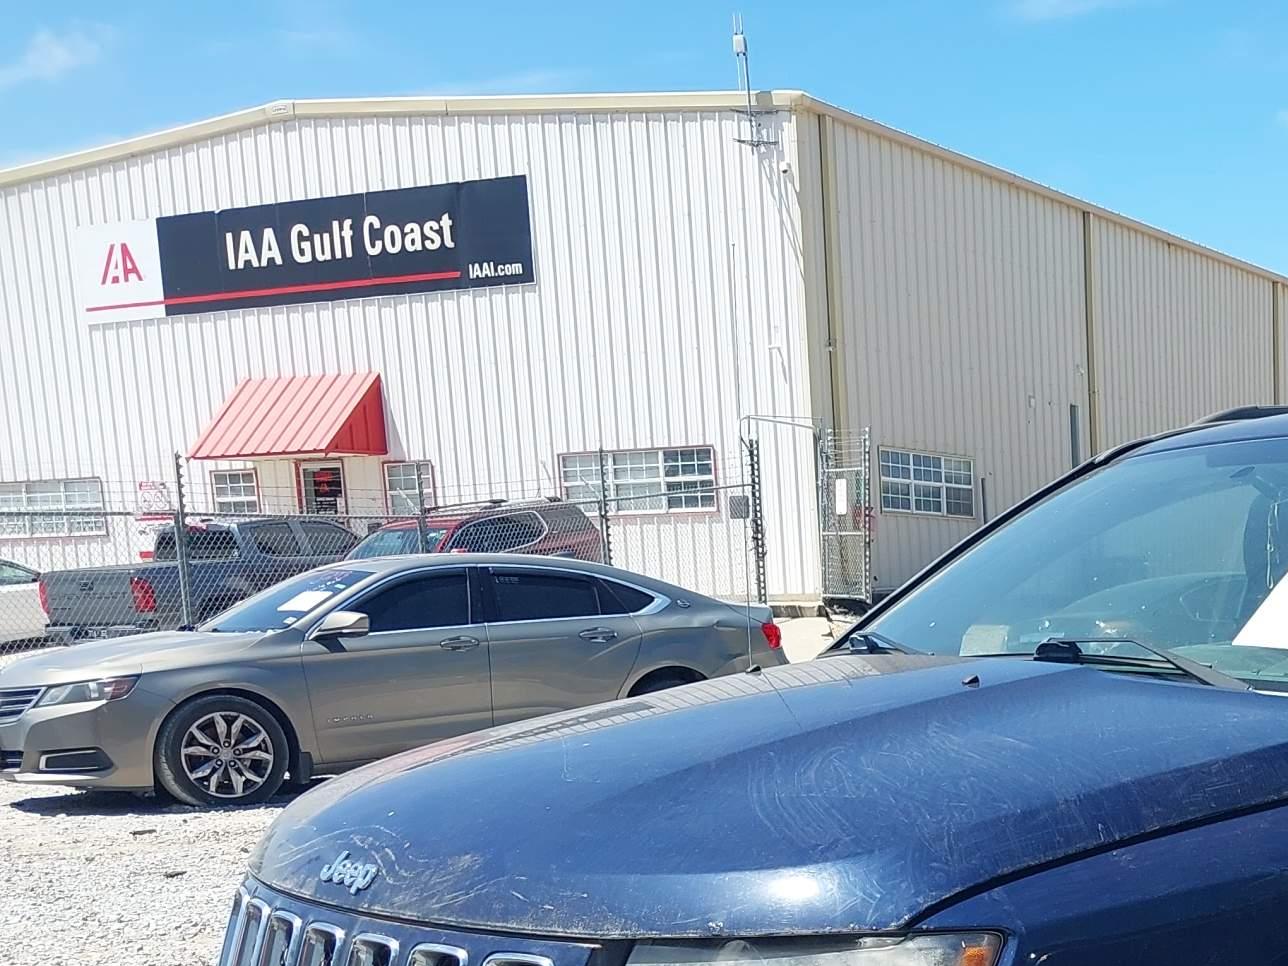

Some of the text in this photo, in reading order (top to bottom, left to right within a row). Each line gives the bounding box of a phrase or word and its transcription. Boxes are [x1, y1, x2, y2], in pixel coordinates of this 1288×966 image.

[225, 212, 455, 270] IAA Gulf Coast
[469, 261, 523, 279] IAAI.com
[320, 850, 378, 895] Jeep
